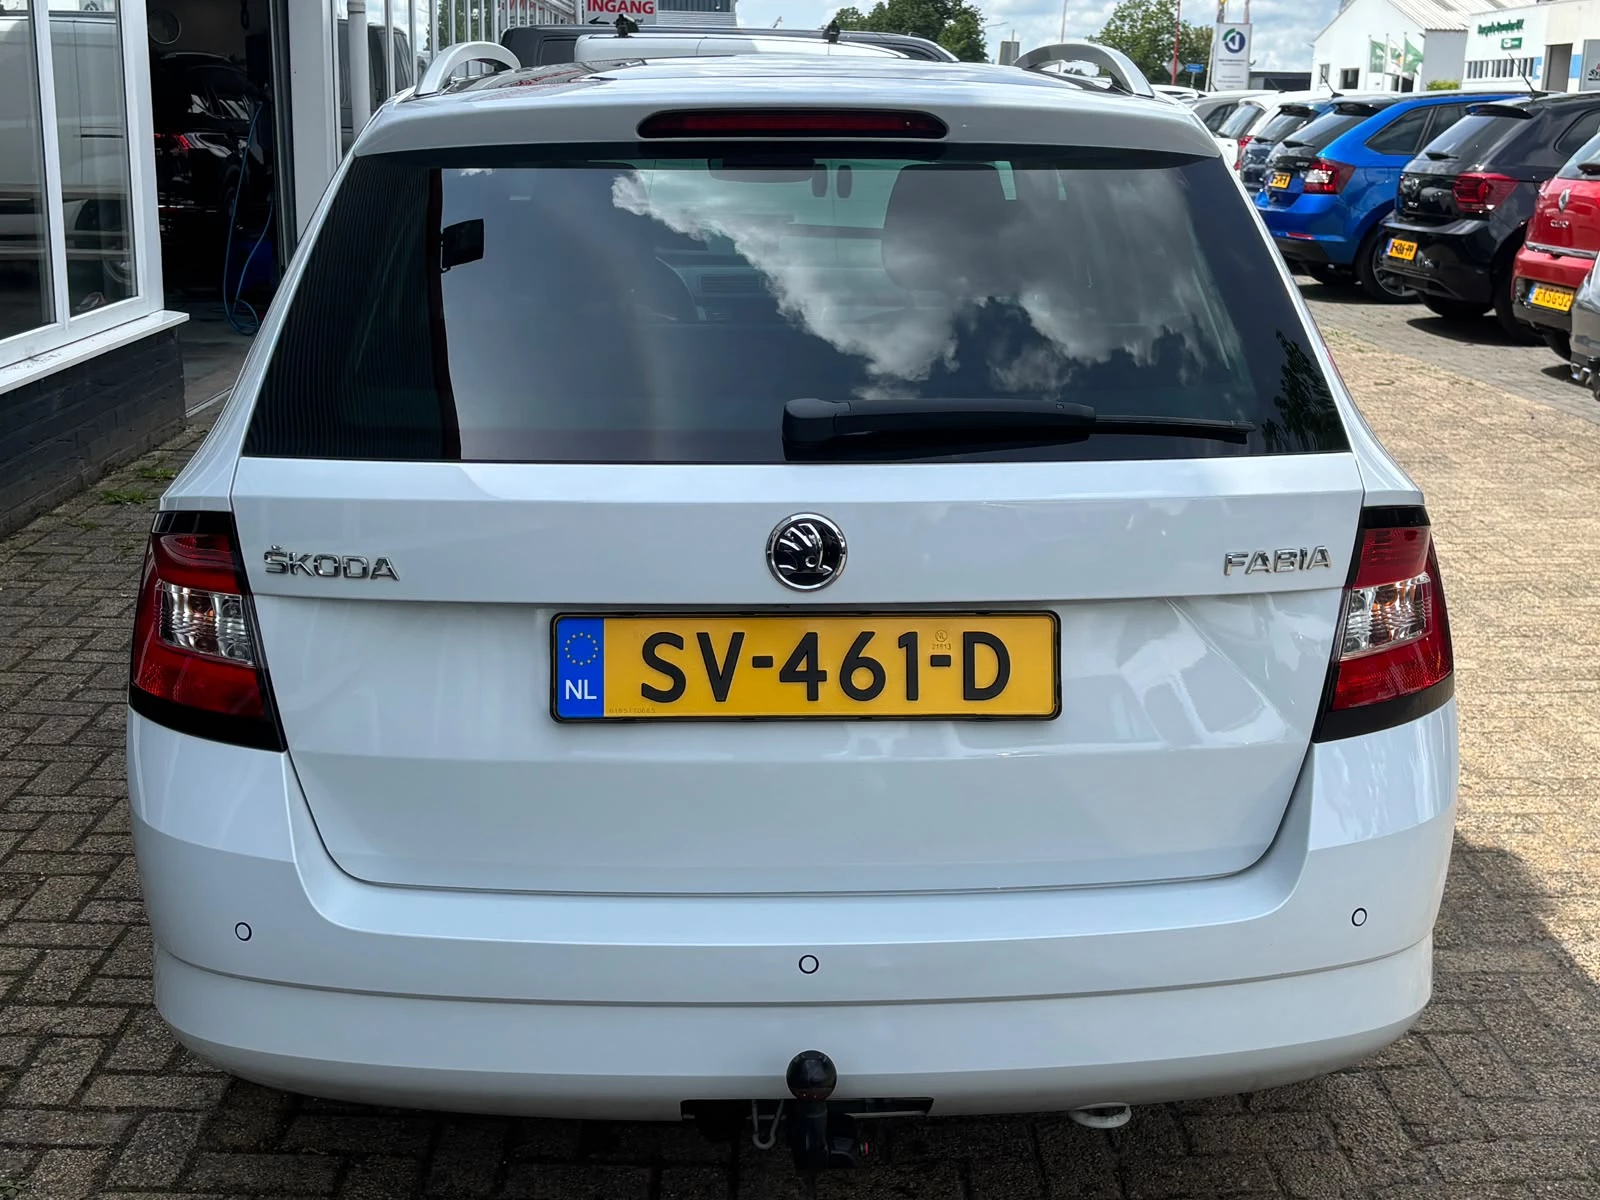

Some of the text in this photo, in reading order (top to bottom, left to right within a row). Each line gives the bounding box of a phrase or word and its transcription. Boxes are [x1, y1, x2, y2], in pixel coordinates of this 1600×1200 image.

[587, 0, 655, 14] INGANG
[264, 544, 401, 581] ŠKODA
[1224, 545, 1332, 576] FABIA
[641, 630, 1011, 703] SV-461-D
[565, 679, 597, 700] NL
